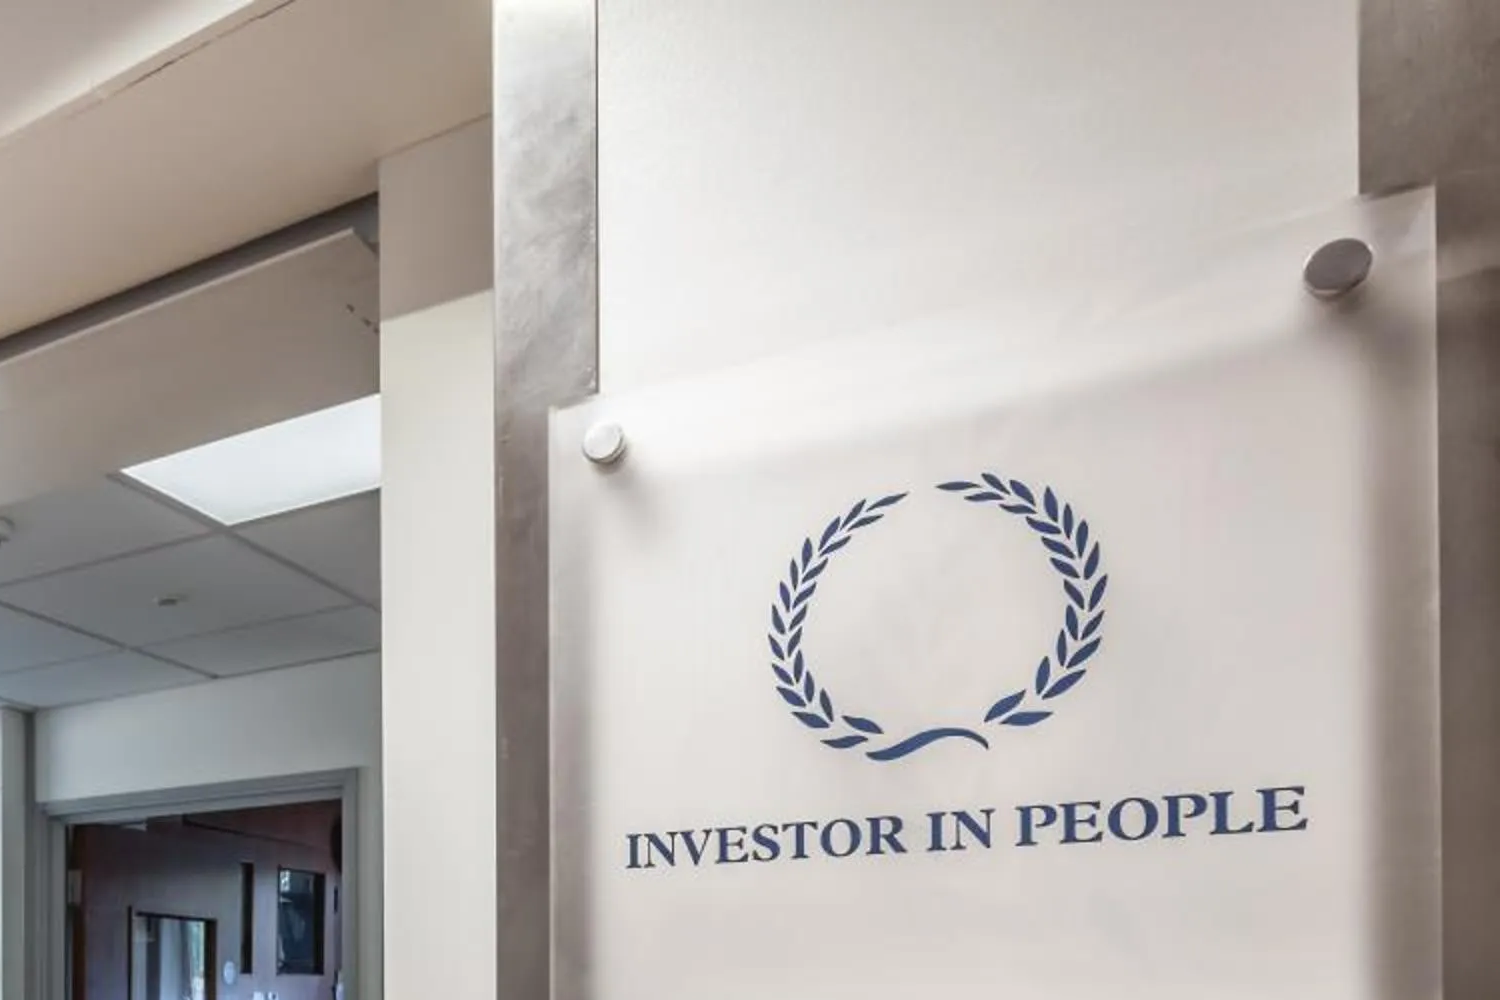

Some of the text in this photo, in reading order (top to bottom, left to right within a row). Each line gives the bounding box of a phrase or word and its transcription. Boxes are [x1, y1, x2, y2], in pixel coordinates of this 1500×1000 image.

[626, 785, 1309, 869] INVESTOR IN PEOPLE
